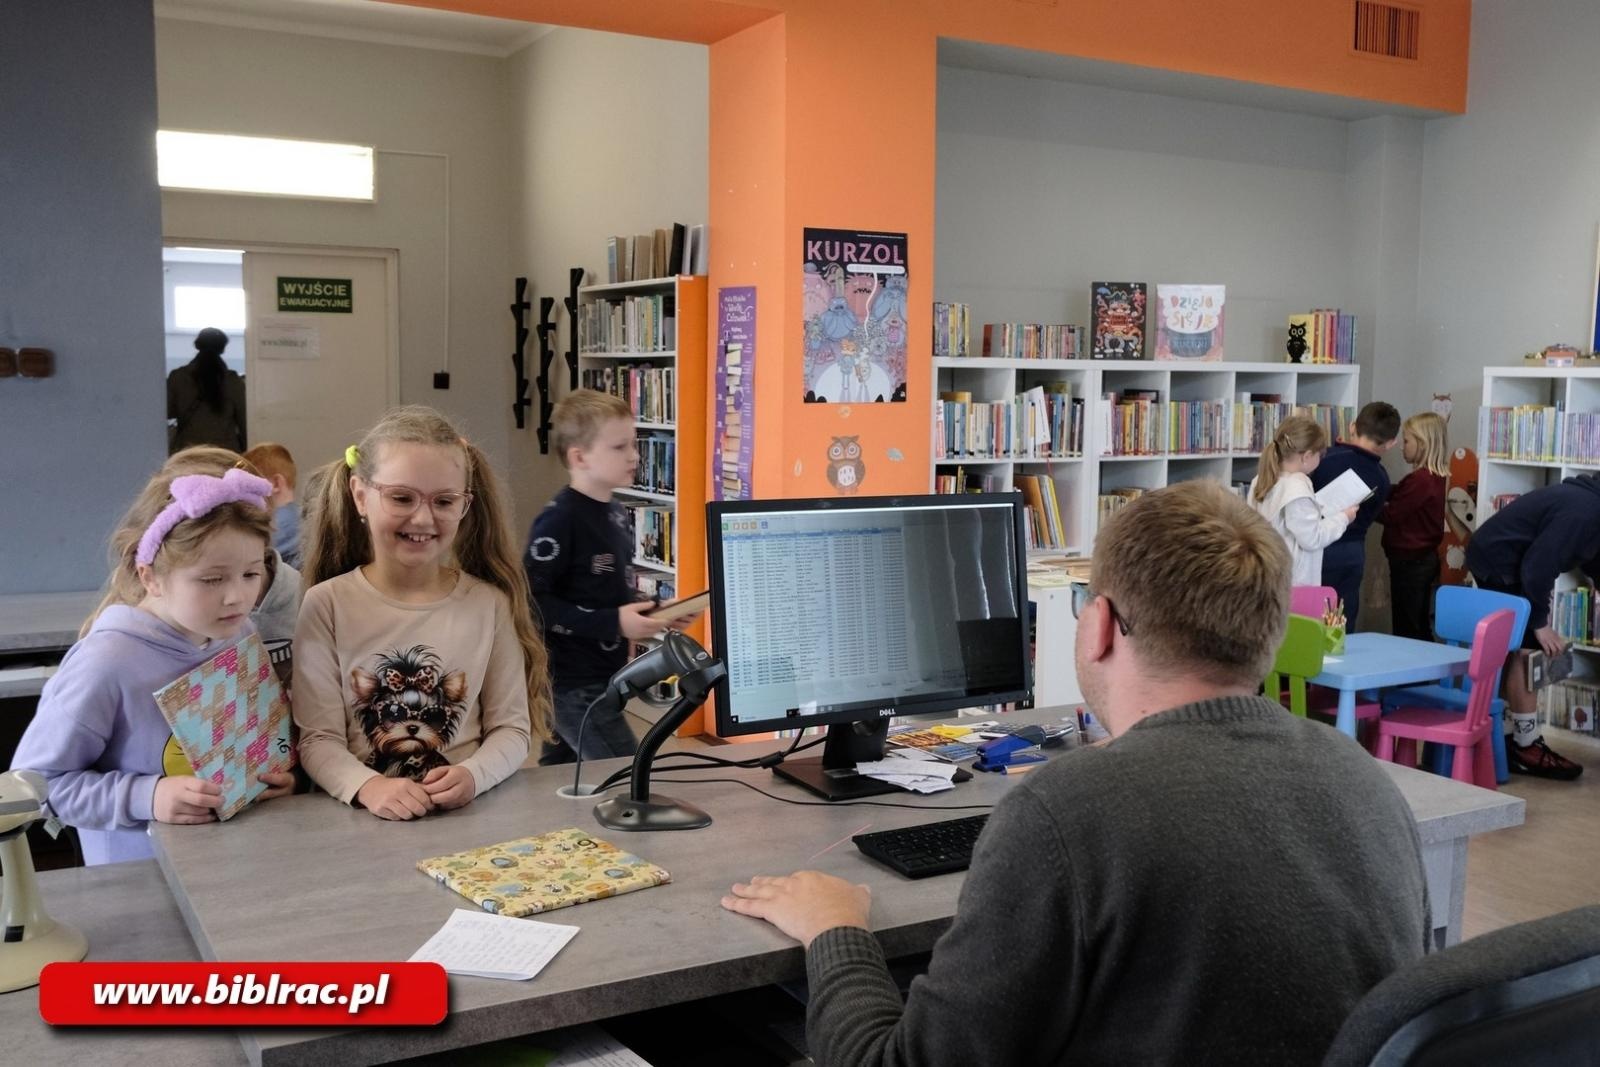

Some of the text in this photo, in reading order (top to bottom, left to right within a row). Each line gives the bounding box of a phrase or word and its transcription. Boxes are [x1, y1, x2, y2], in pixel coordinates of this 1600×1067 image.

[807, 240, 904, 264] KURZOL
[283, 281, 347, 296] WYJŚCIE
[280, 297, 351, 307] EWAKUACYJNE
[880, 708, 896, 716] DELL
